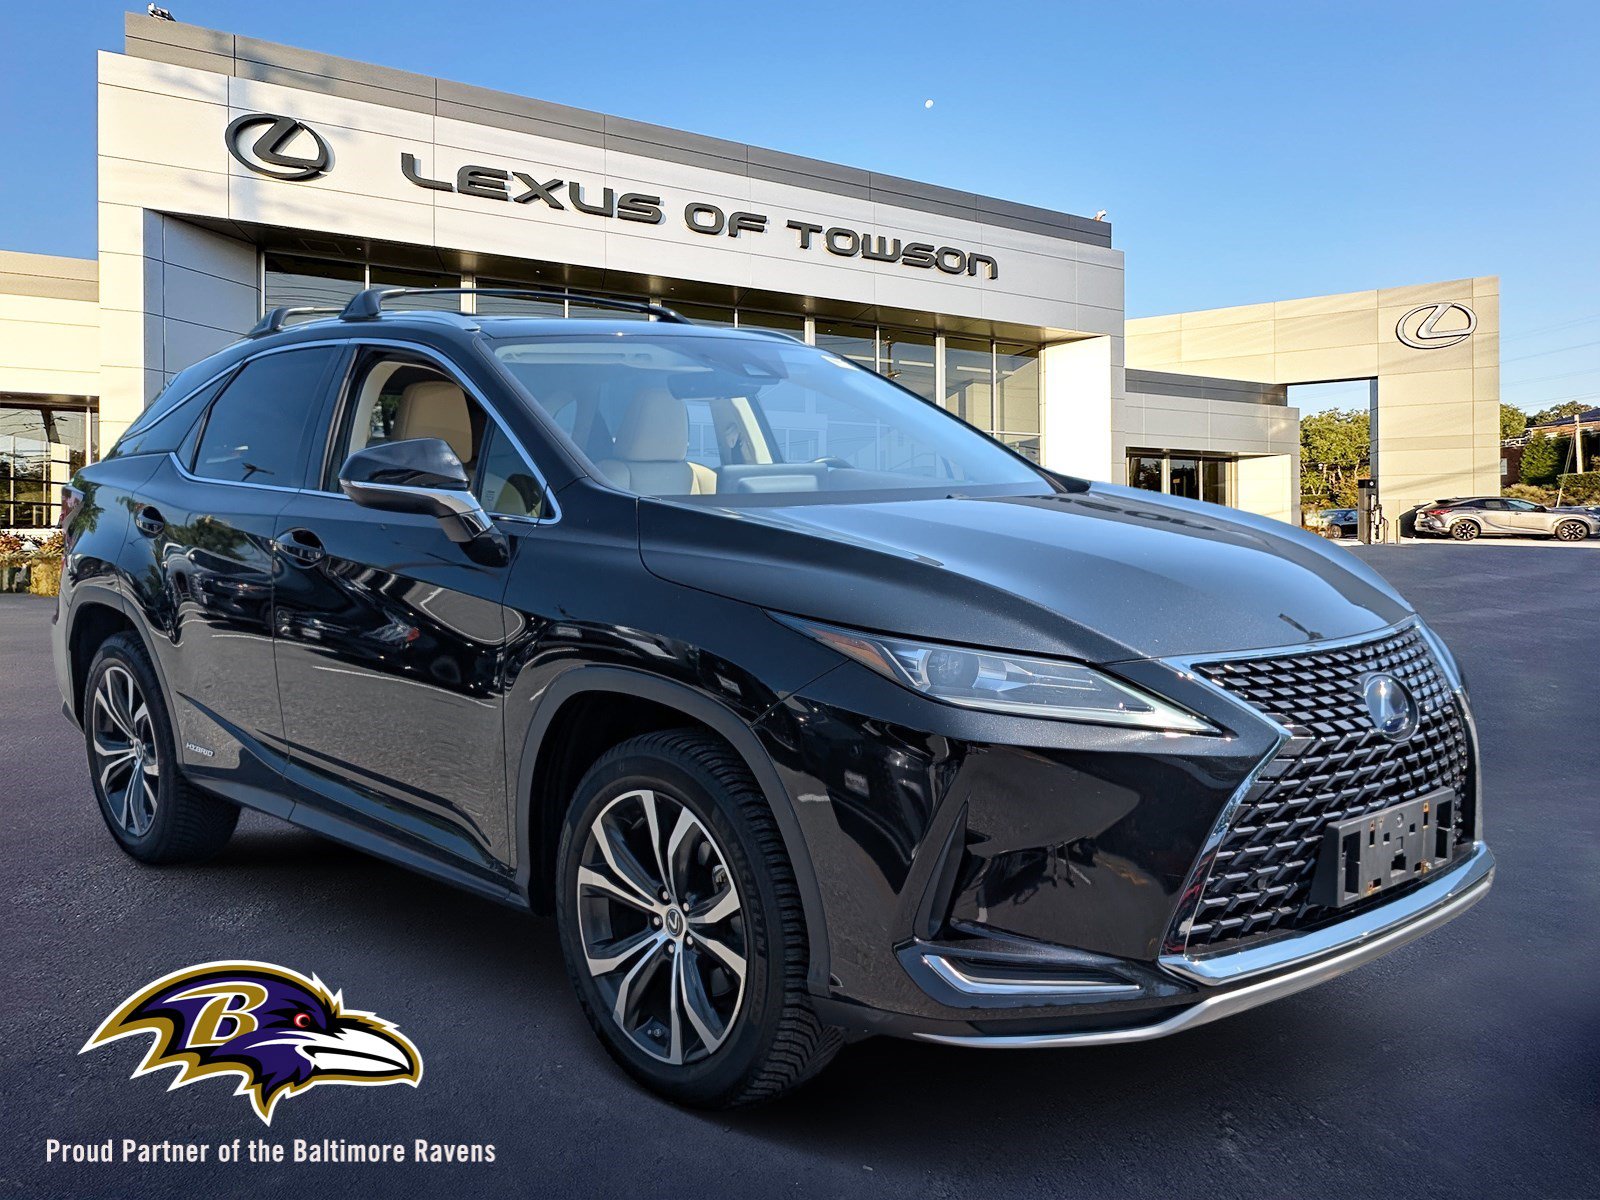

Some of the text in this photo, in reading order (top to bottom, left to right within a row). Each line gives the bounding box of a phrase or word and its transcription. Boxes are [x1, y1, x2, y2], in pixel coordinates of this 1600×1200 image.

[401, 152, 998, 280] LEXUS OF TOWSON
[186, 742, 214, 757] HYBRID
